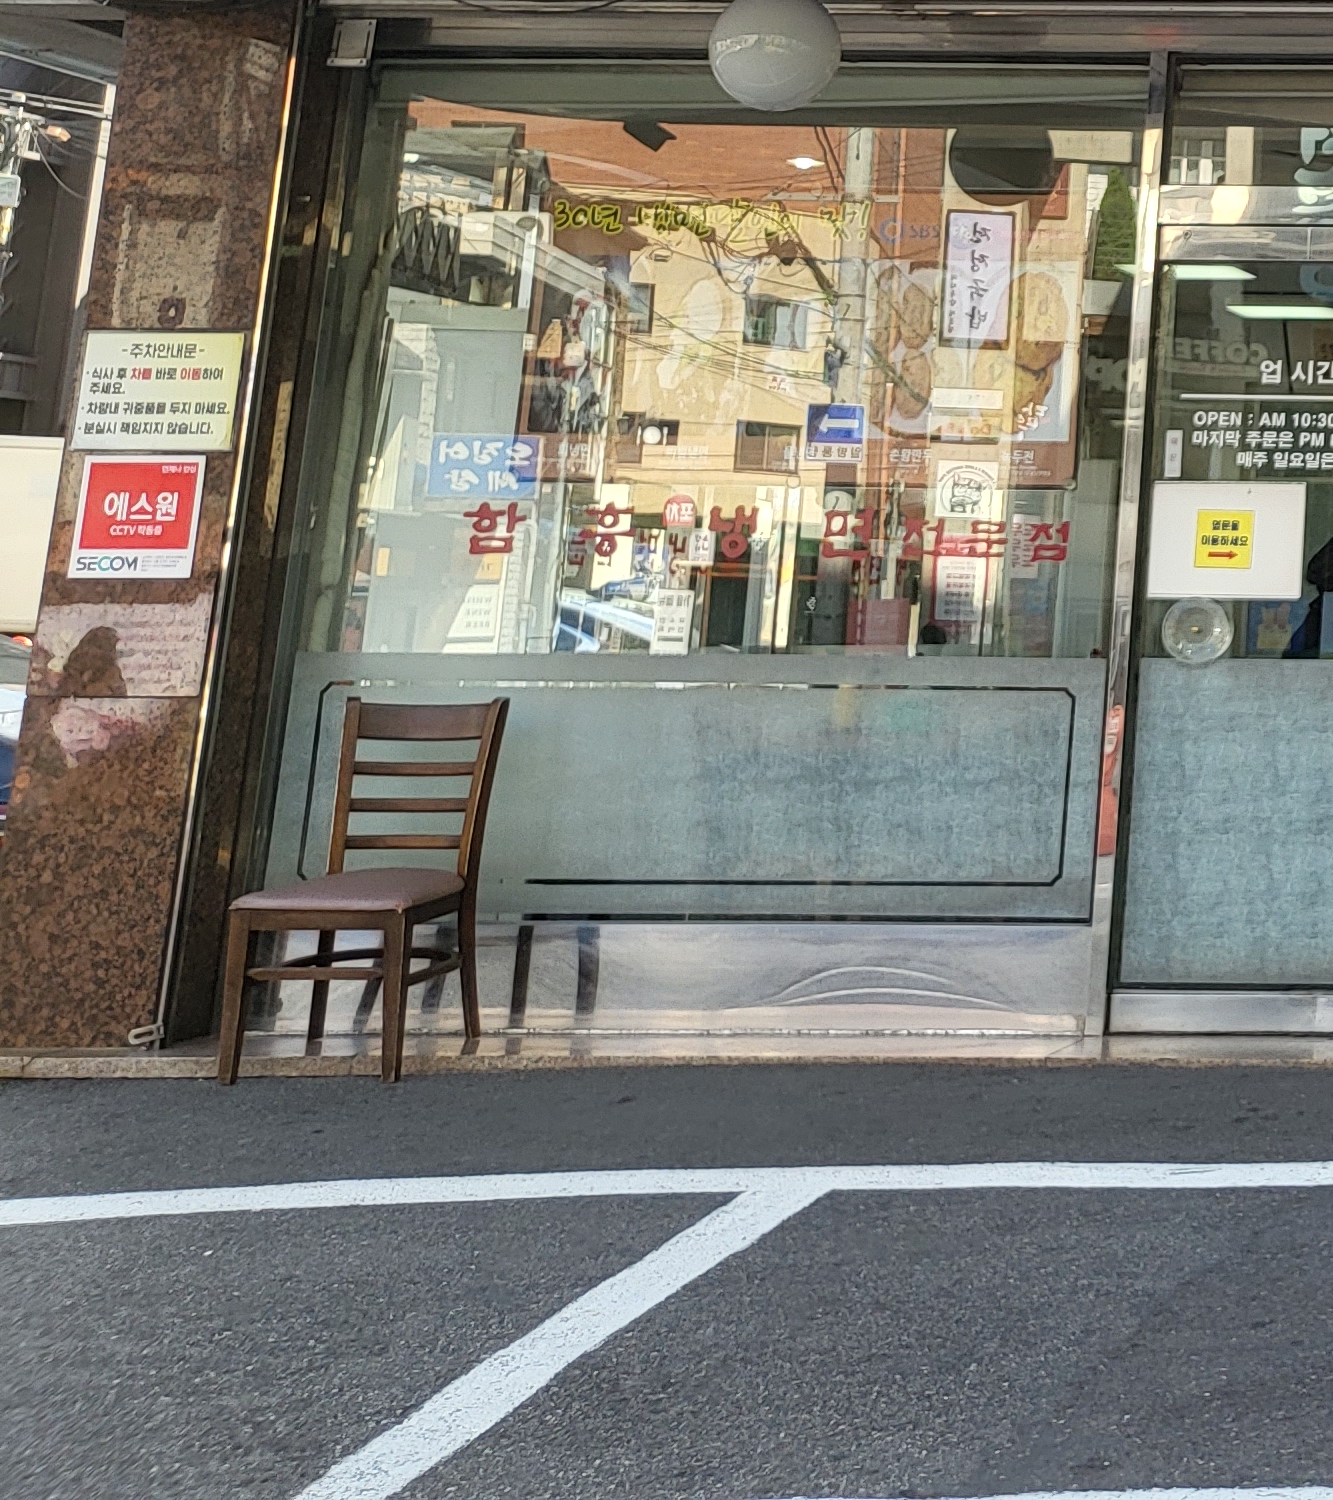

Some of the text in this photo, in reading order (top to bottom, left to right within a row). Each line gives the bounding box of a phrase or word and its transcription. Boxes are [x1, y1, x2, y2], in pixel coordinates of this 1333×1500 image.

[555, 200, 622, 234] 30년
[91, 367, 114, 380] 식사
[155, 367, 177, 380] 바로
[89, 382, 126, 394] 주세요.
[169, 402, 191, 415] 두지
[194, 402, 230, 415] 마세요.
[1192, 411, 1243, 428] OPEN
[1259, 412, 1286, 428] AM
[1191, 430, 1242, 449] 마지막
[1245, 430, 1295, 449] 주문은
[1298, 432, 1325, 448] PM
[1236, 451, 1269, 469] 매주
[103, 491, 179, 521] 에스원
[109, 524, 136, 535] CCTV
[1201, 535, 1249, 546] 이용하세요
[75, 556, 139, 571] SECOM
